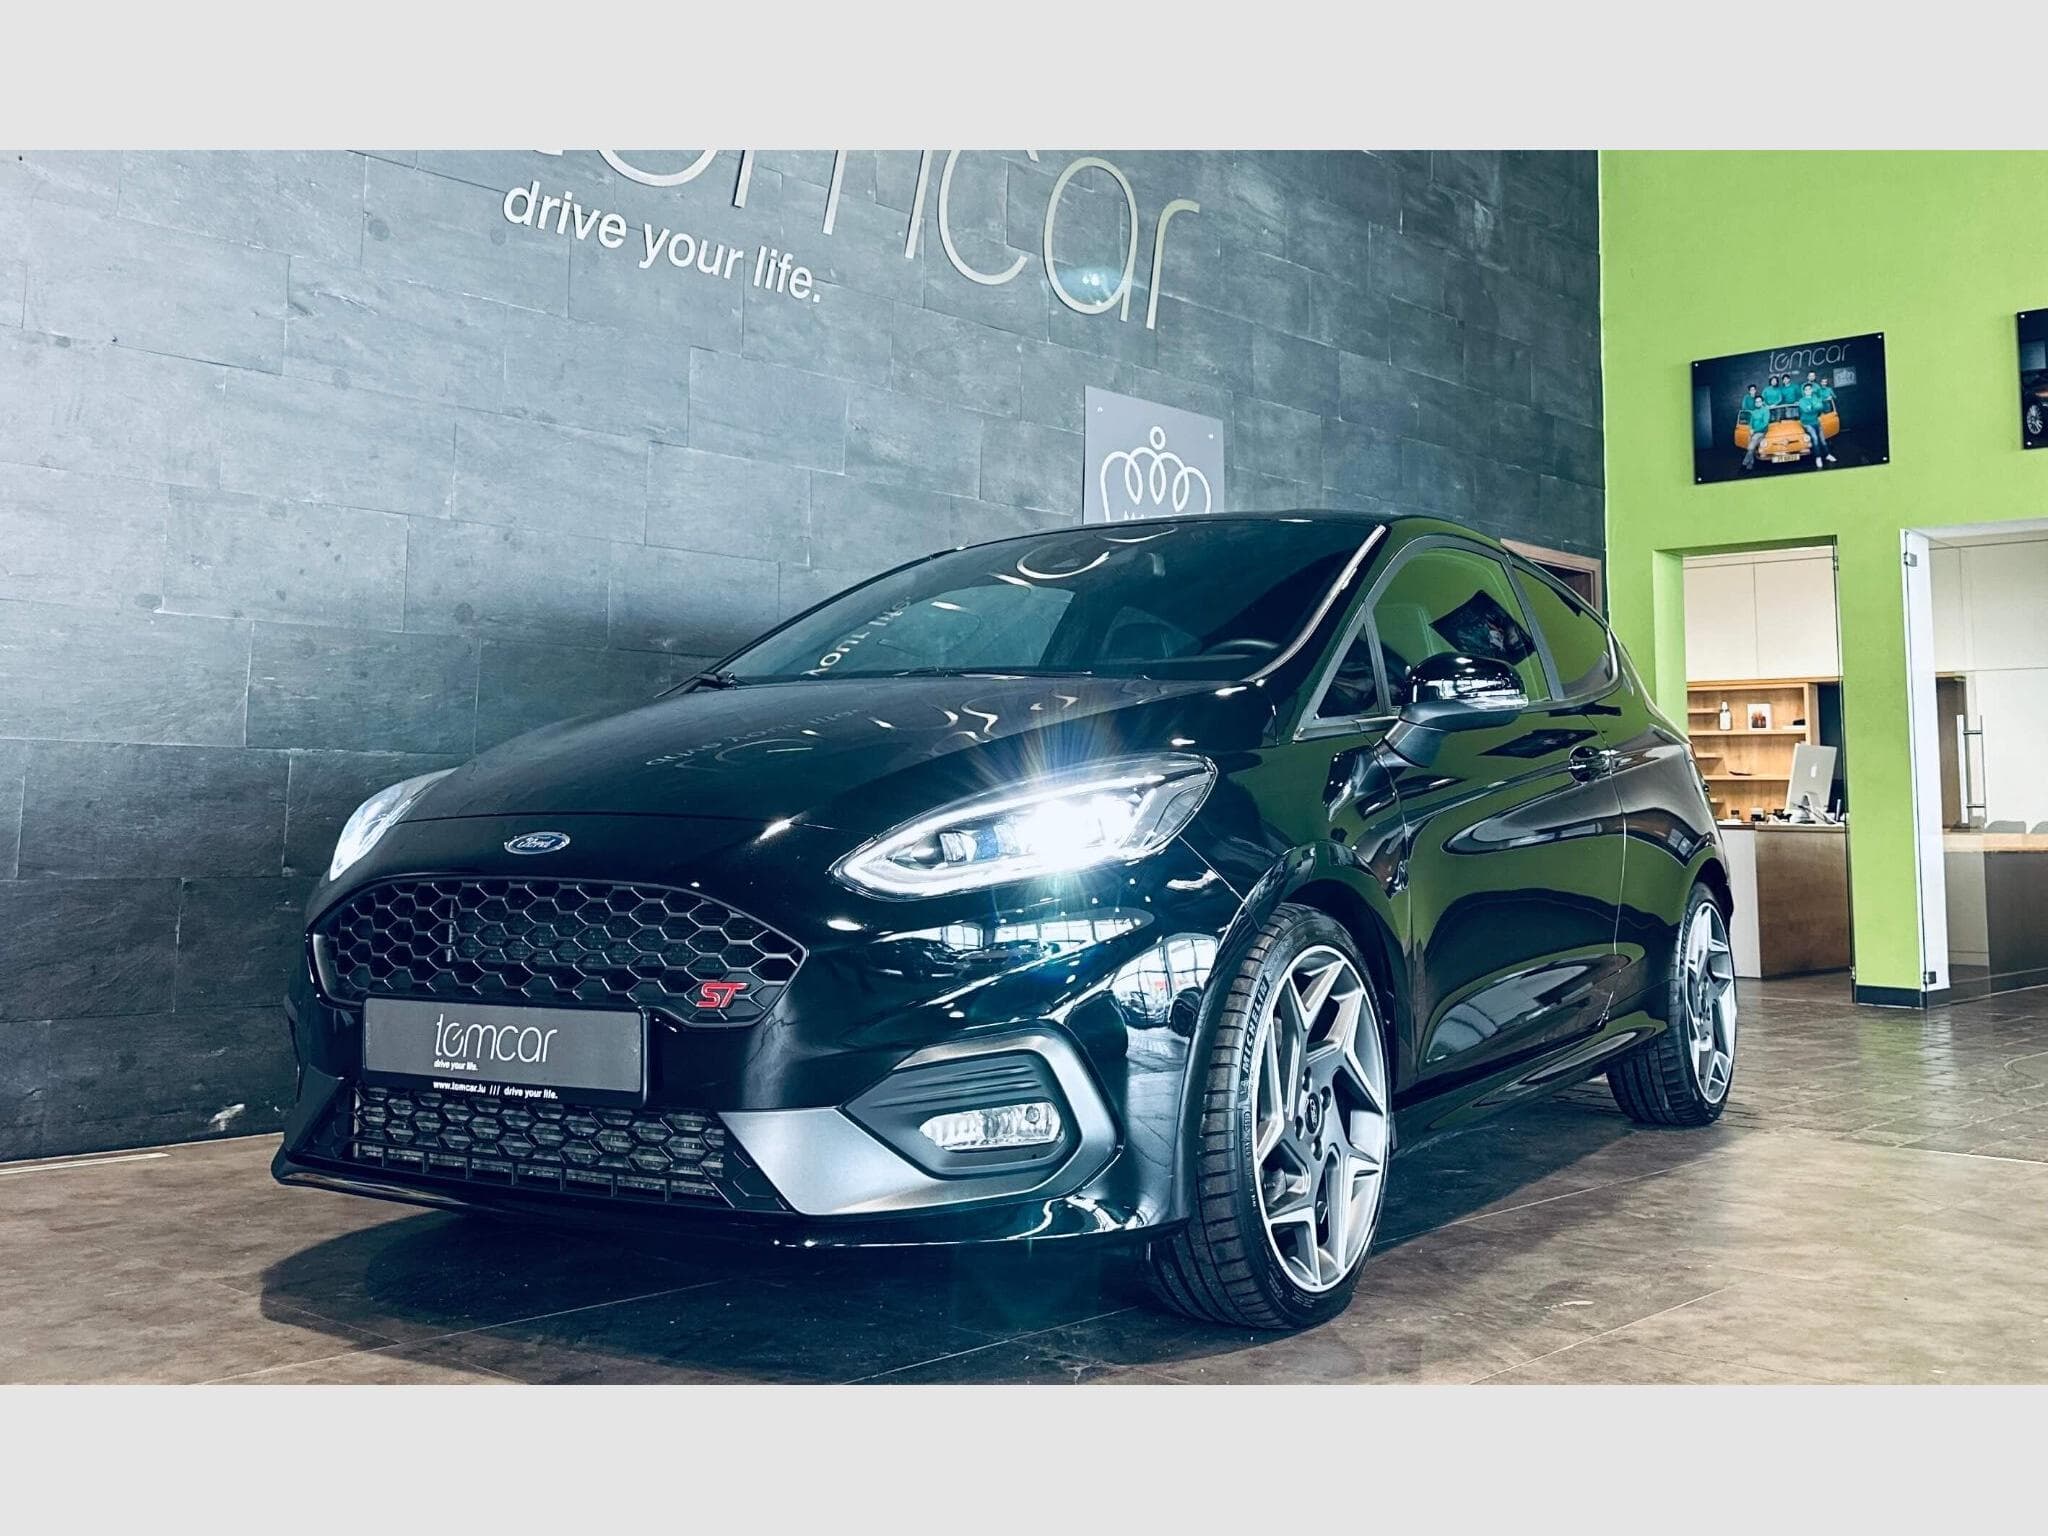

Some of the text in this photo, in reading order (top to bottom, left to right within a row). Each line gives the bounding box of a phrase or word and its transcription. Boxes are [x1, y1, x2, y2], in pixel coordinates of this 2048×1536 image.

[502, 180, 821, 304] drive your life.
[530, 150, 1200, 331] car
[1769, 343, 1851, 372] tomcar
[695, 981, 748, 1009] ST
[435, 1013, 558, 1063] tomcar
[1241, 974, 1269, 1076] MICHELIN
[432, 1081, 486, 1094] www.tomcar.lu
[503, 1086, 523, 1097] drive
[524, 1089, 542, 1099] your
[543, 1088, 558, 1100] life.
